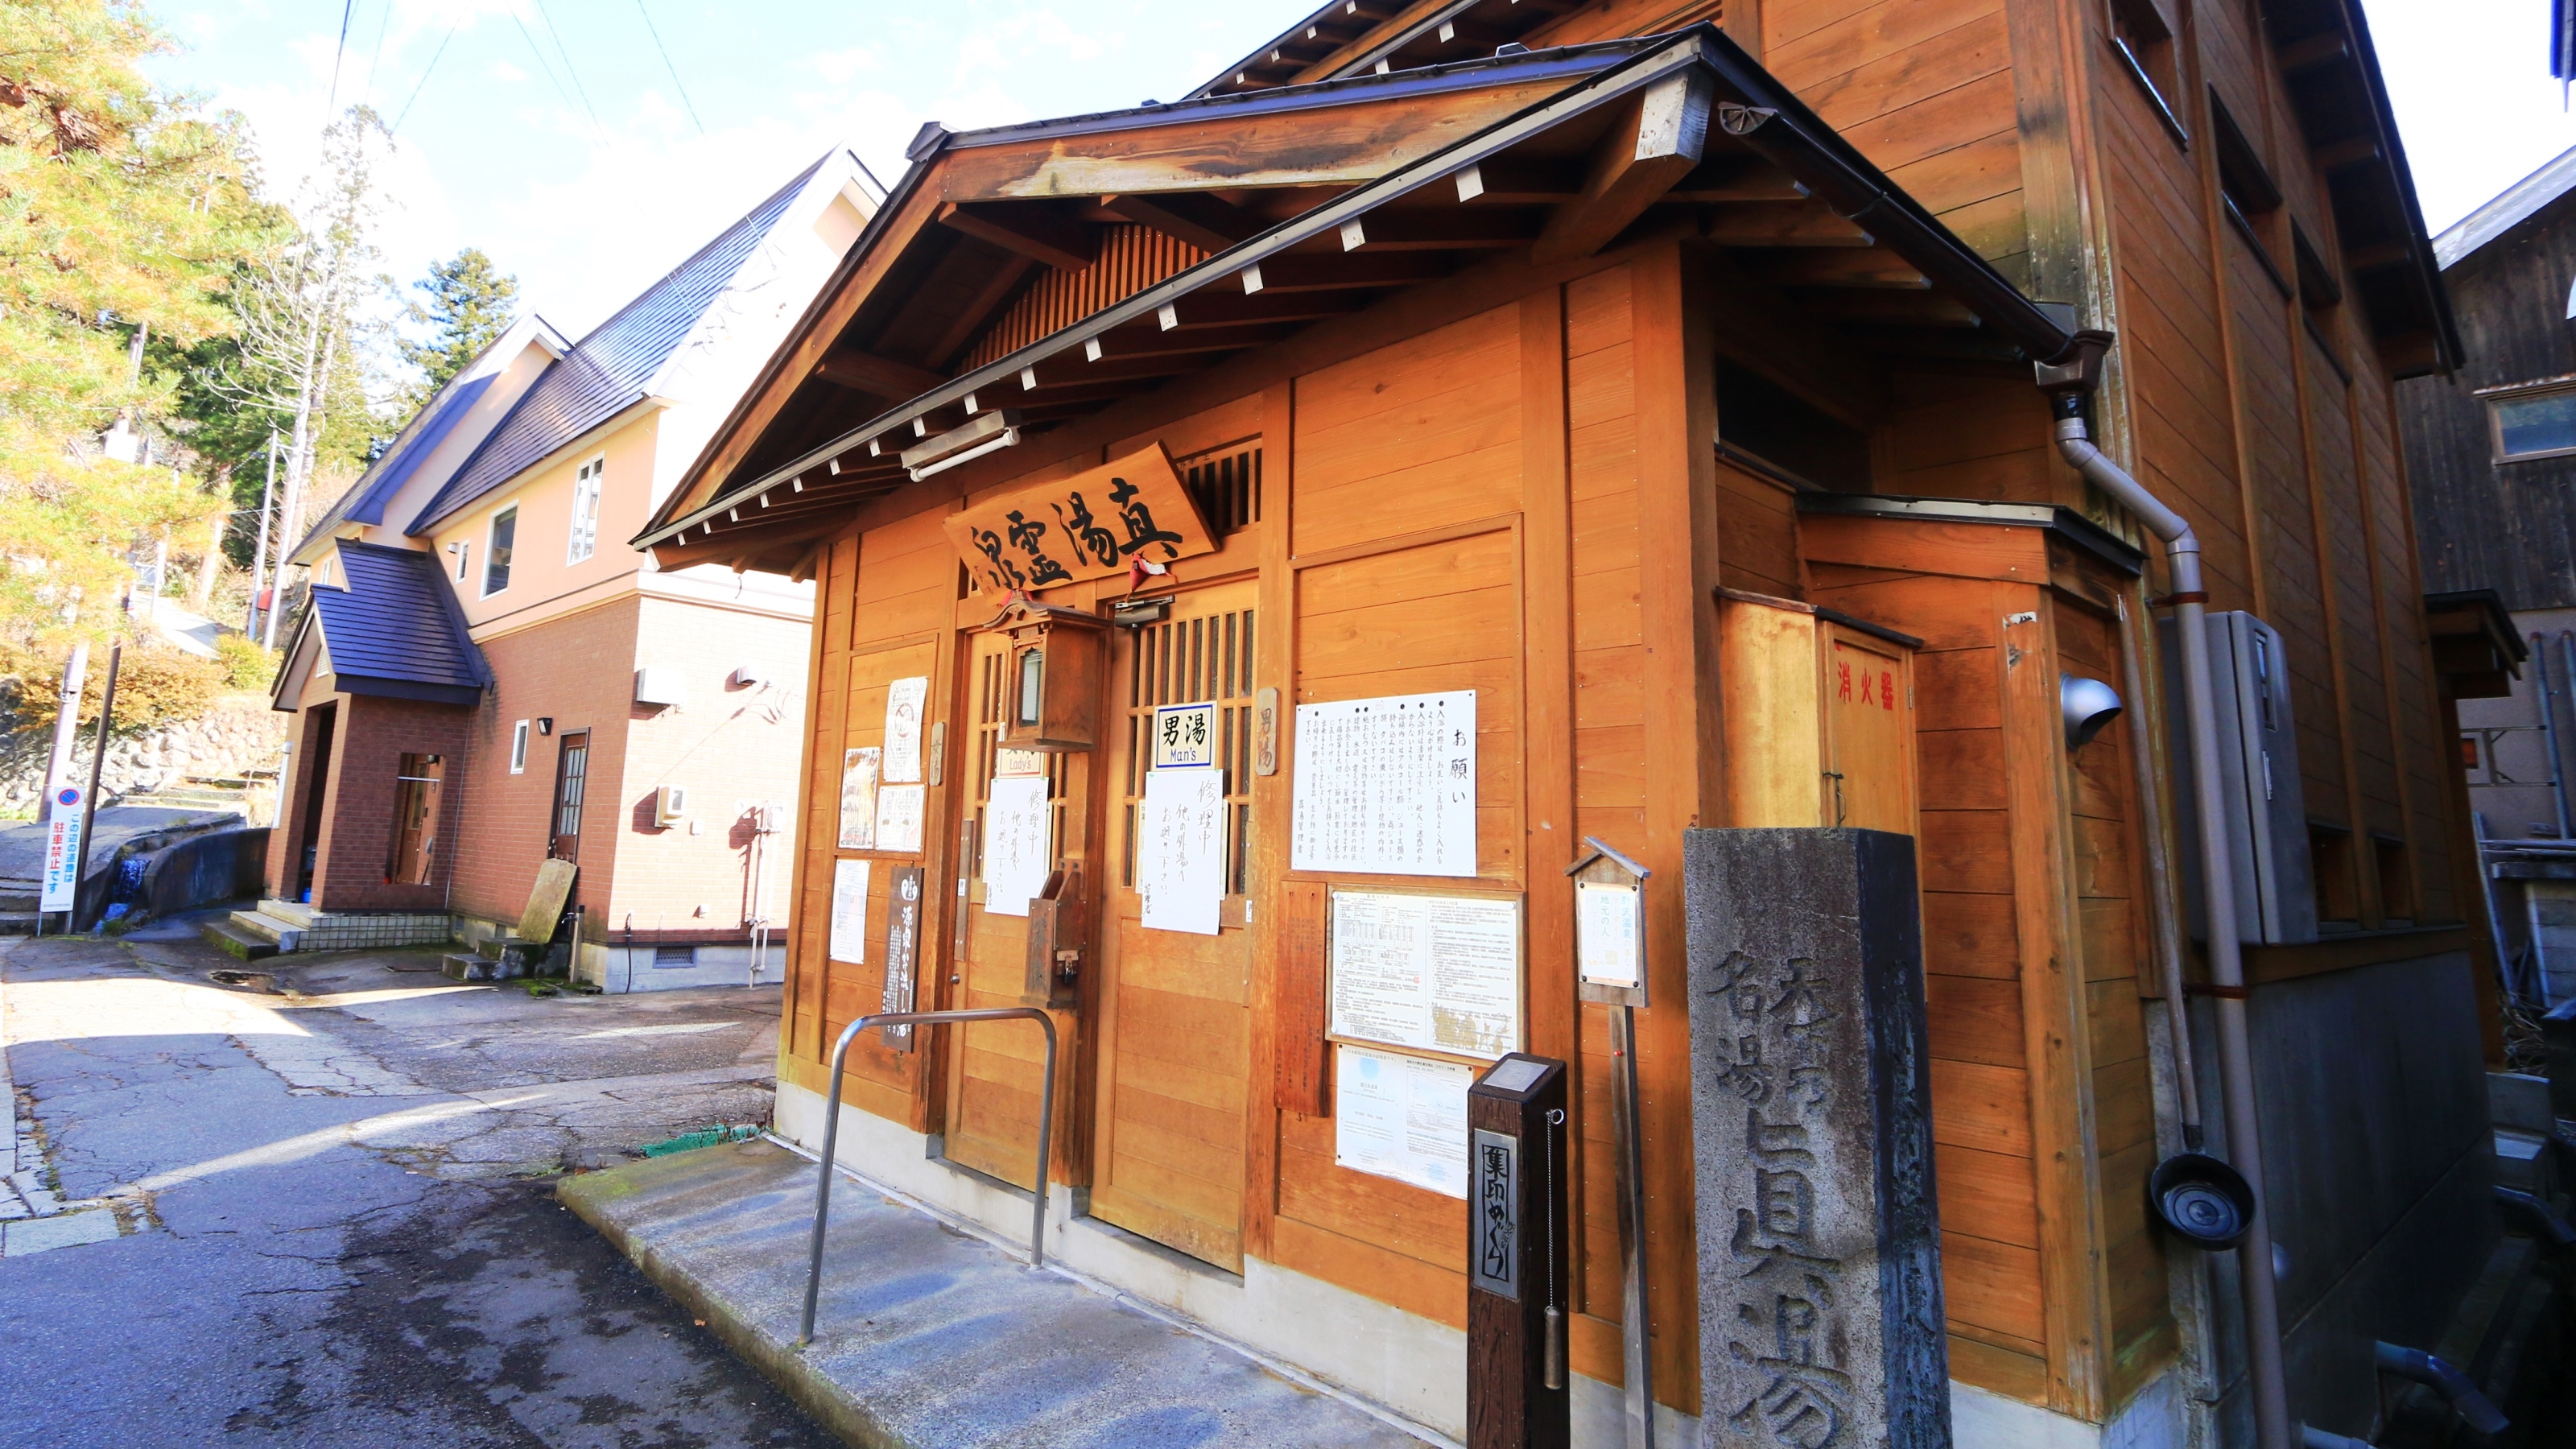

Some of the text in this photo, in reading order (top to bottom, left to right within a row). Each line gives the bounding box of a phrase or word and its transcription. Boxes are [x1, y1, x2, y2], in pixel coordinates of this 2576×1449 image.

[1838, 660, 1894, 711] 消火器
[1163, 713, 1207, 746] 男湯
[1170, 747, 1197, 763] Man's
[1257, 708, 1274, 768] 男湯
[1009, 755, 1032, 771] Lady's
[1450, 728, 1468, 803] お願い
[64, 813, 79, 882] この辺の道路は
[1027, 788, 1044, 857] 修理中
[1197, 779, 1219, 856] 修理中
[47, 822, 65, 894] 駐車禁止です
[1600, 894, 1610, 946] 地元の人に
[1484, 1147, 1508, 1277] 集印めぐり
